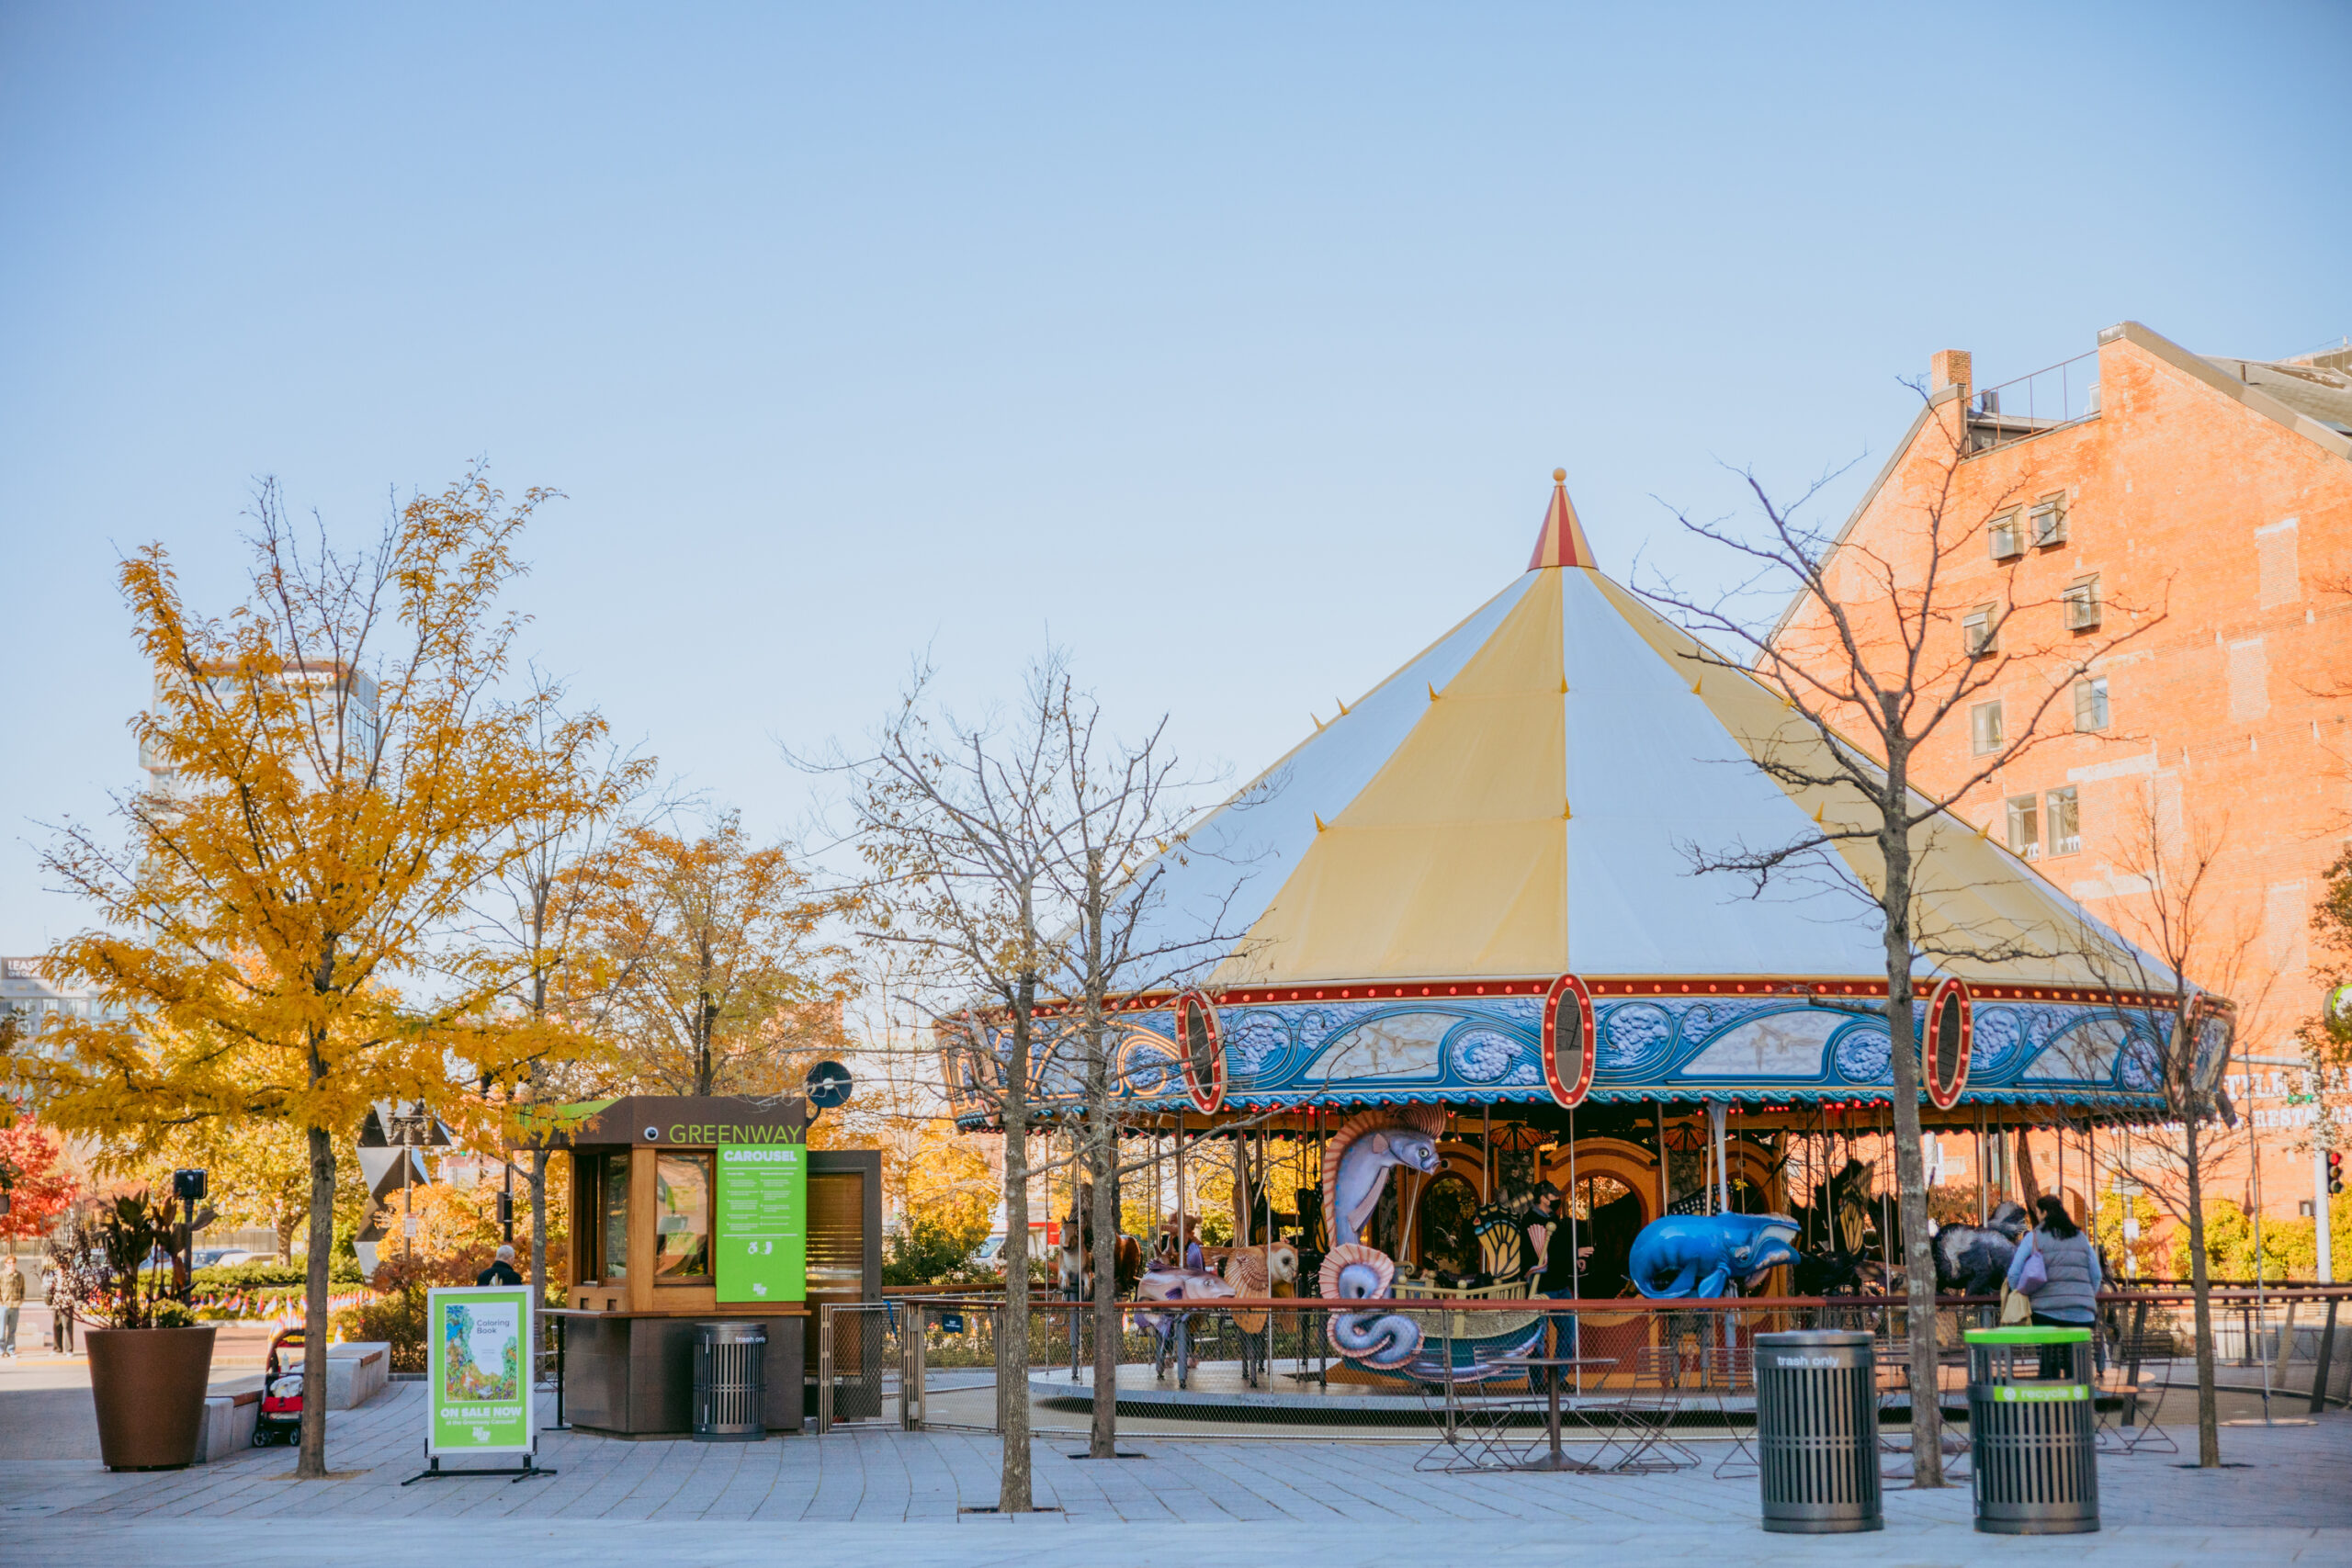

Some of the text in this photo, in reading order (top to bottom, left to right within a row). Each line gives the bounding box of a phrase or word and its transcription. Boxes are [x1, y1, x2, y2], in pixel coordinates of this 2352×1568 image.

[669, 1124, 802, 1144] GREENWAY
[723, 1150, 797, 1162] CAROUSEL
[477, 1319, 510, 1327] Coloring
[1777, 1355, 1839, 1368] trash only
[2021, 1388, 2069, 1401] recycle
[441, 1406, 522, 1417] ON SALE NOW
